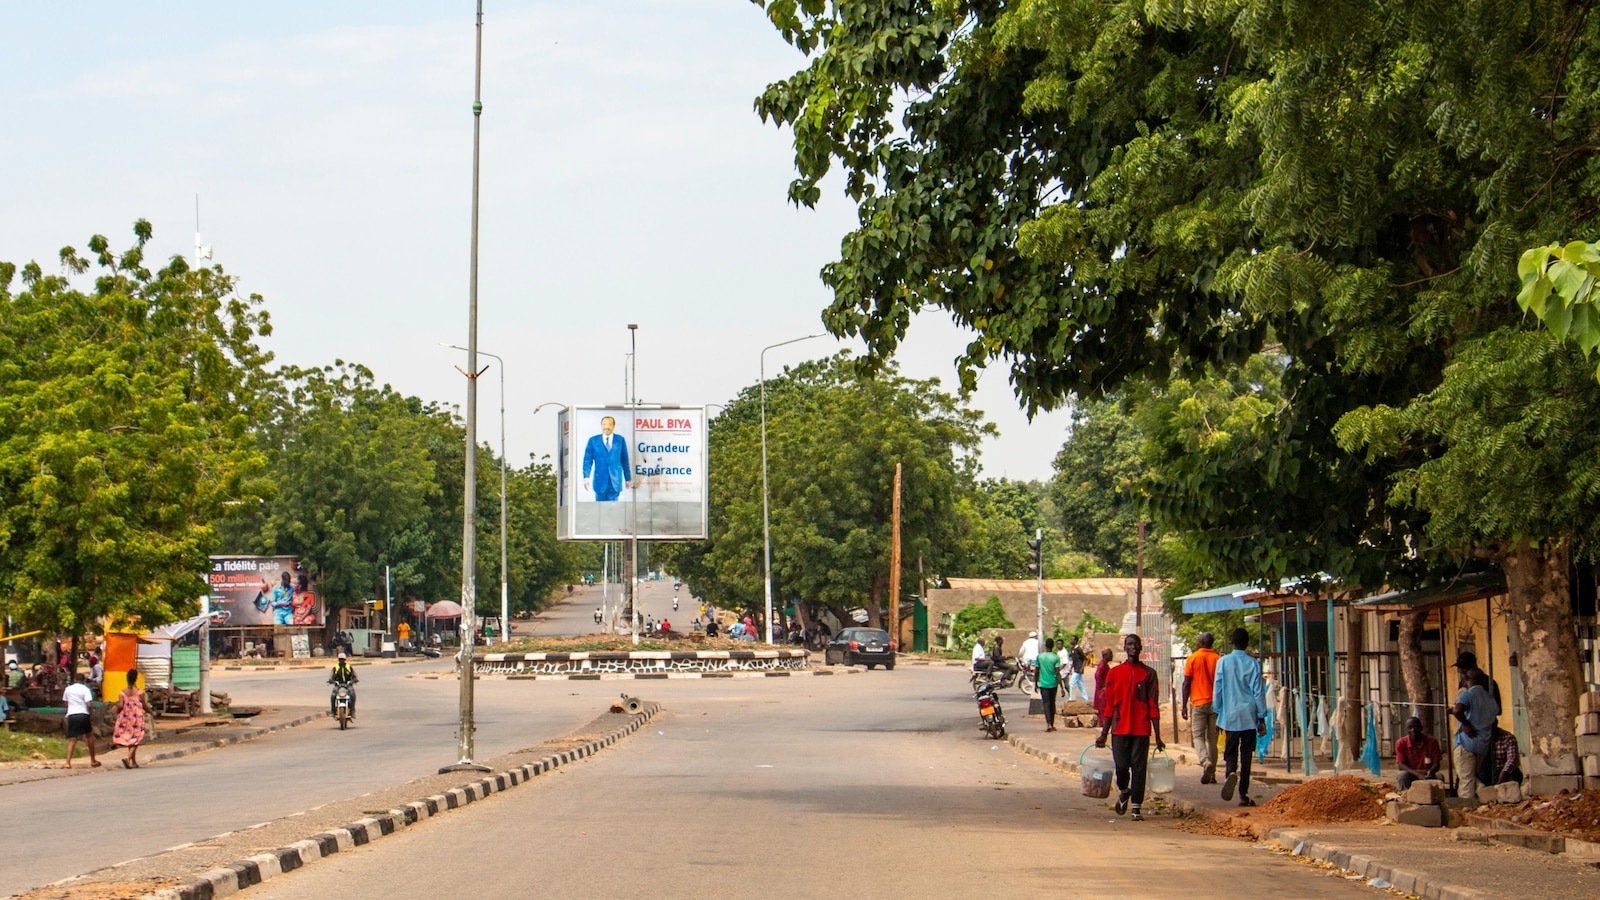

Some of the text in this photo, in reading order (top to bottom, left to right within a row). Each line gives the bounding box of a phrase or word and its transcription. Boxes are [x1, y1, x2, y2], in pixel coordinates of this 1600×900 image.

[635, 418, 692, 429] PAUL BIYA
[638, 442, 690, 453] Grandeur
[635, 464, 692, 477] Espérance
[224, 561, 257, 571] fidélité
[259, 561, 279, 572] paie
[210, 574, 225, 583] 500
